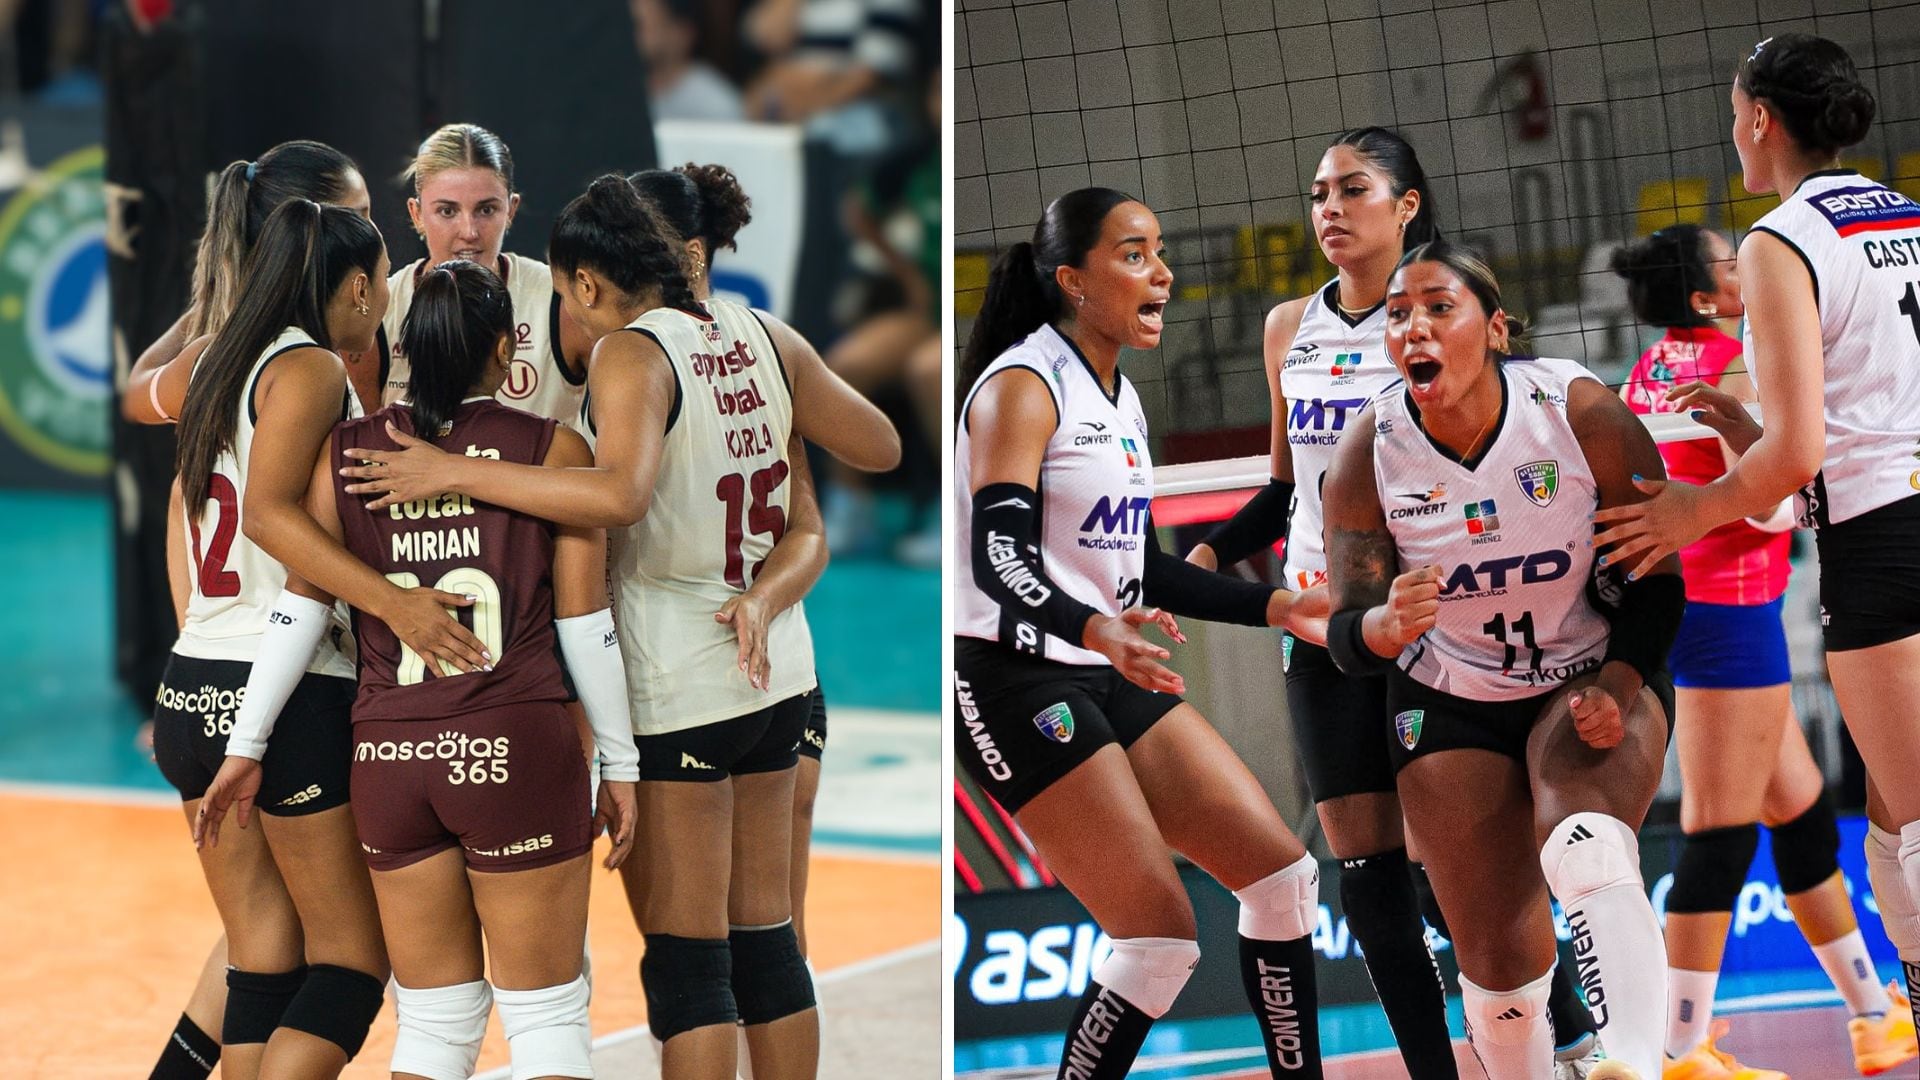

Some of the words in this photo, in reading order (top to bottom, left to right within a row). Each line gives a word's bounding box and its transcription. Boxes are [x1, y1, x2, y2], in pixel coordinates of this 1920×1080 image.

[1863, 236, 1920, 269] CAST
[1898, 280, 1920, 347] 1
[1289, 397, 1372, 431] MT
[725, 423, 773, 460] KARLA
[1074, 434, 1112, 446] CONVERT
[715, 459, 789, 591] 15
[1079, 495, 1152, 536] MT
[1390, 502, 1448, 520] CONVERT
[391, 526, 480, 562] MIRIAN
[1471, 534, 1502, 546] JIMENEZ
[987, 530, 1052, 608] CONVERT
[1483, 610, 1544, 673] 11
[203, 711, 237, 738] 36
[953, 669, 1013, 782] CONVERT
[354, 731, 510, 762] mascotas
[447, 759, 510, 785] 365
[1566, 908, 1609, 1031] CONVERT
[1257, 957, 1303, 1071] CONVERT
[1058, 986, 1128, 1080] ONVERT
